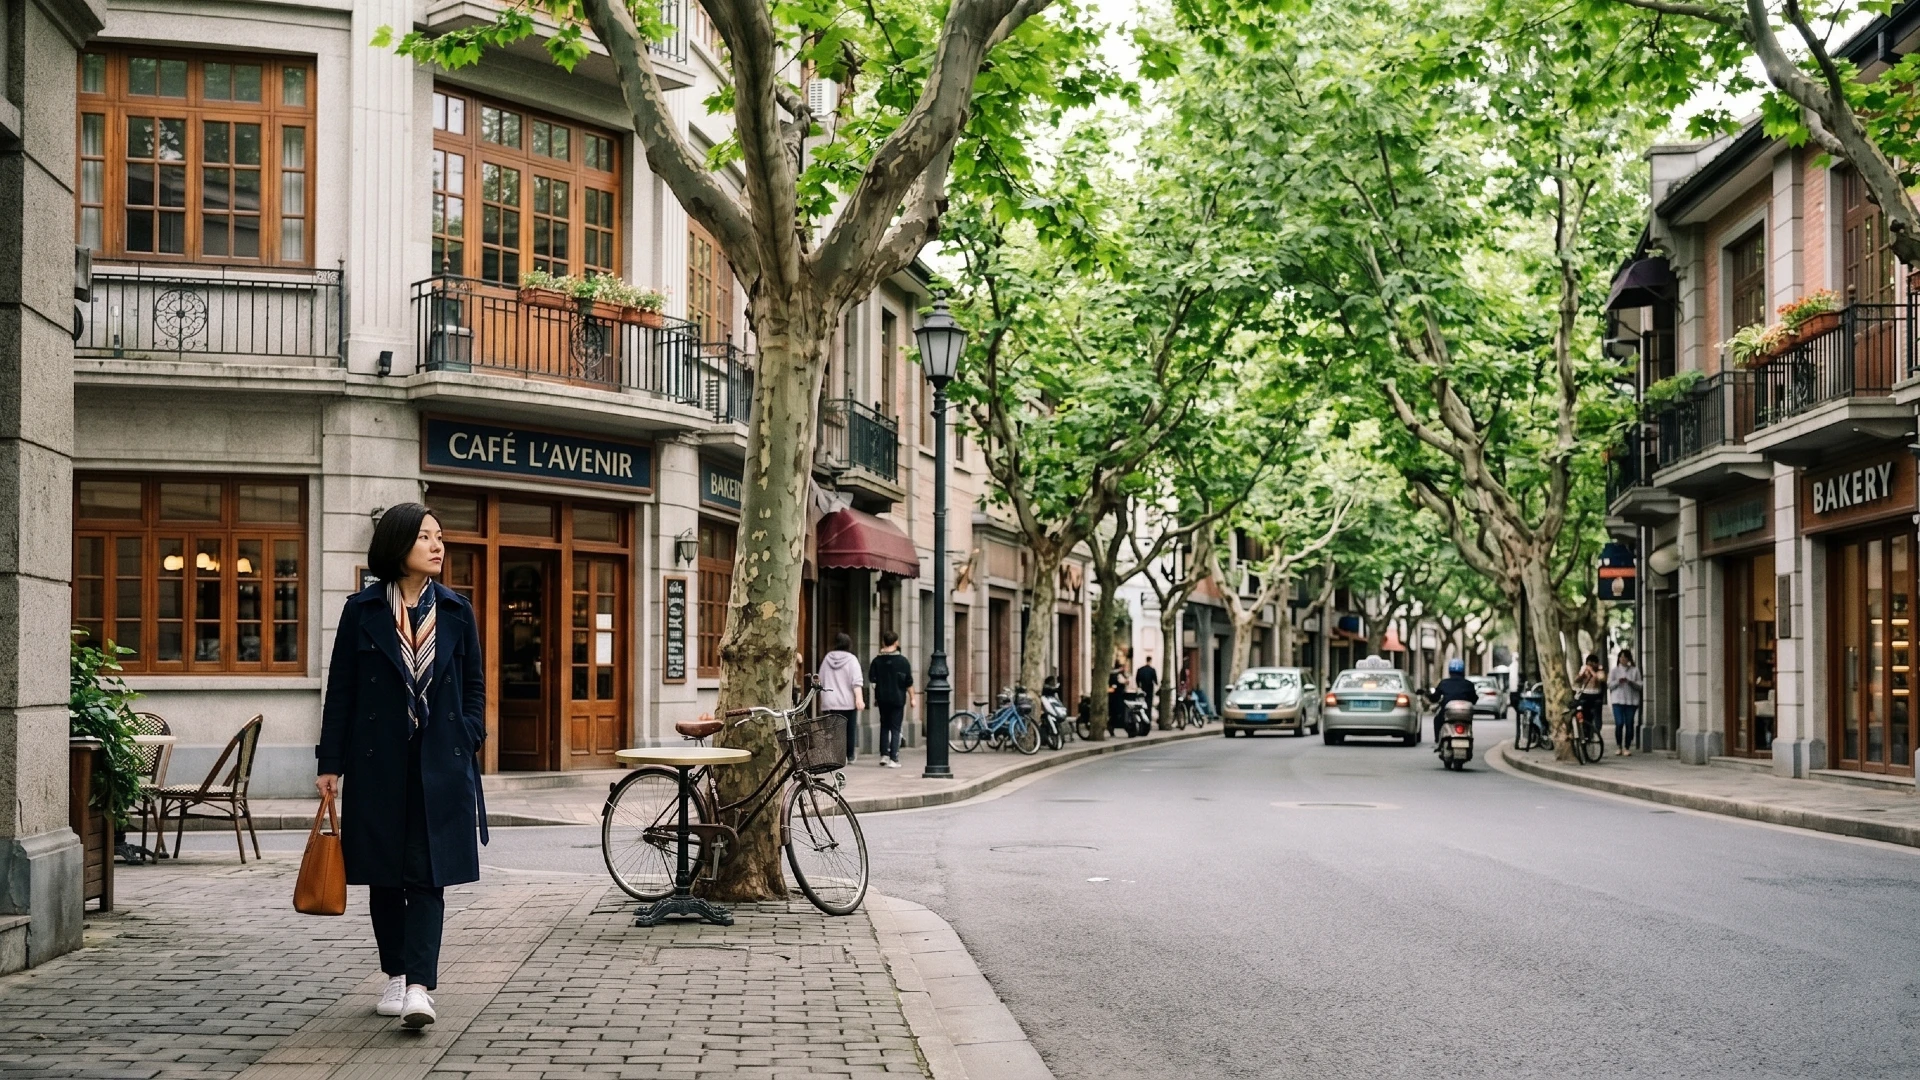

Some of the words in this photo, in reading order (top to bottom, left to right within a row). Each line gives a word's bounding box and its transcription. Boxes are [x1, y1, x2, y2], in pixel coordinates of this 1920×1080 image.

[448, 431, 517, 465] CAFÉ
[529, 441, 633, 478] L'AVENIR
[1813, 461, 1892, 515] BAKERY
